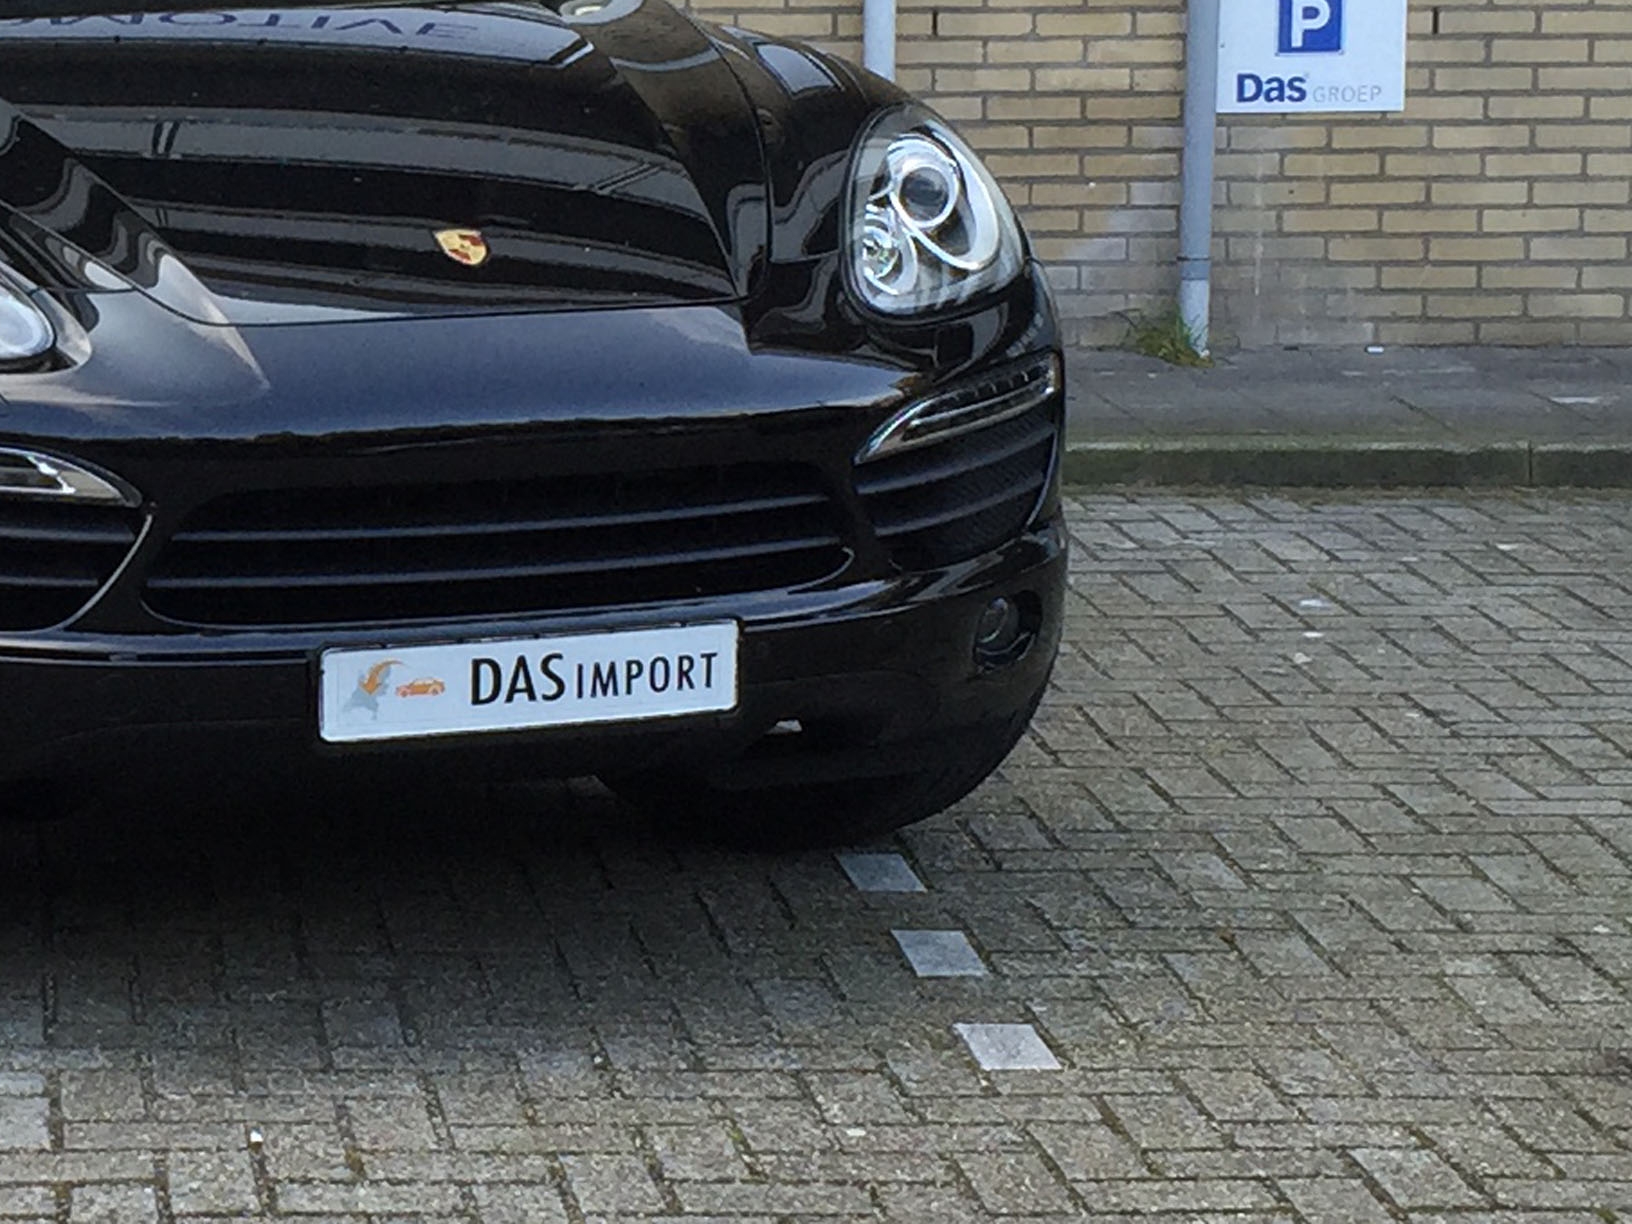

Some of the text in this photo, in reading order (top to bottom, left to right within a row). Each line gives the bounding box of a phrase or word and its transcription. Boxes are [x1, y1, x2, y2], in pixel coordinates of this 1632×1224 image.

[1236, 73, 1383, 104] Das GROEP
[471, 652, 718, 706] DAS IMPORT
